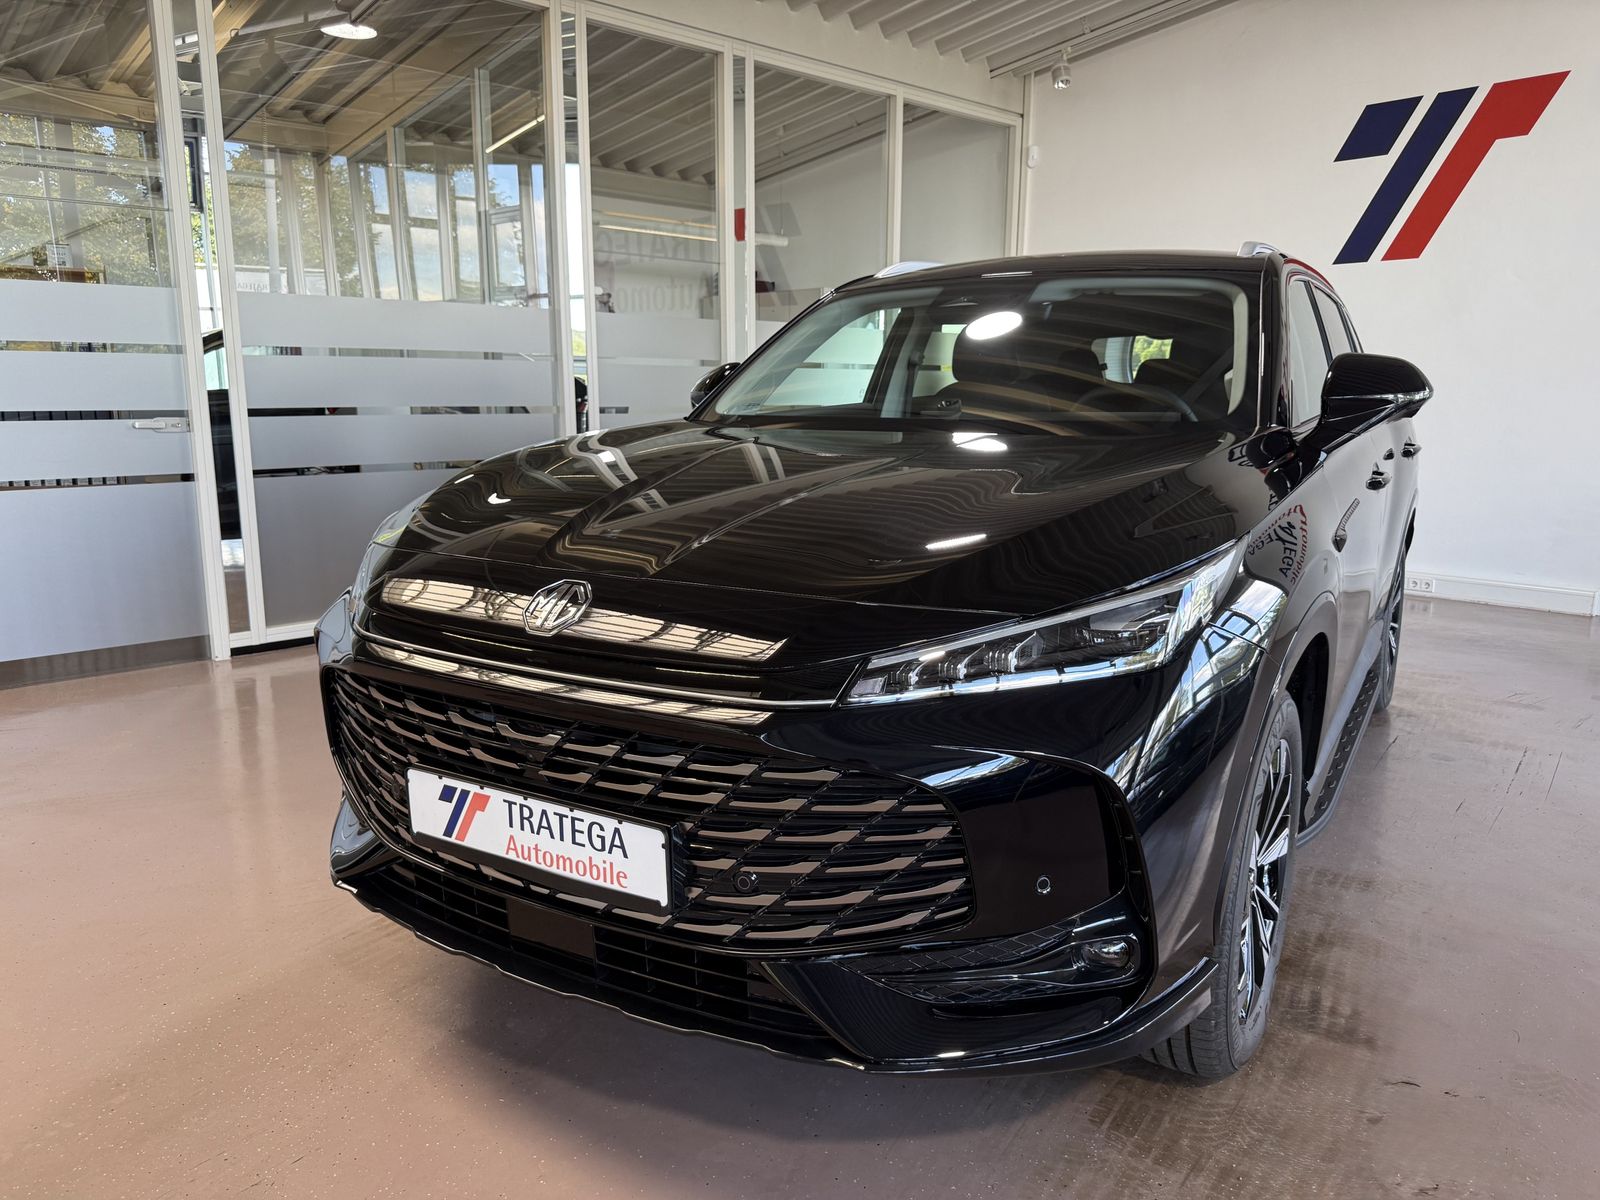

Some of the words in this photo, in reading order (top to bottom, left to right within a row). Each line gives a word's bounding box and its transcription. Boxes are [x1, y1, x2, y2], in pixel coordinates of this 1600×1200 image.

[525, 579, 591, 635] MG
[503, 799, 628, 859] TRATEGA
[505, 835, 628, 888] Automobile
